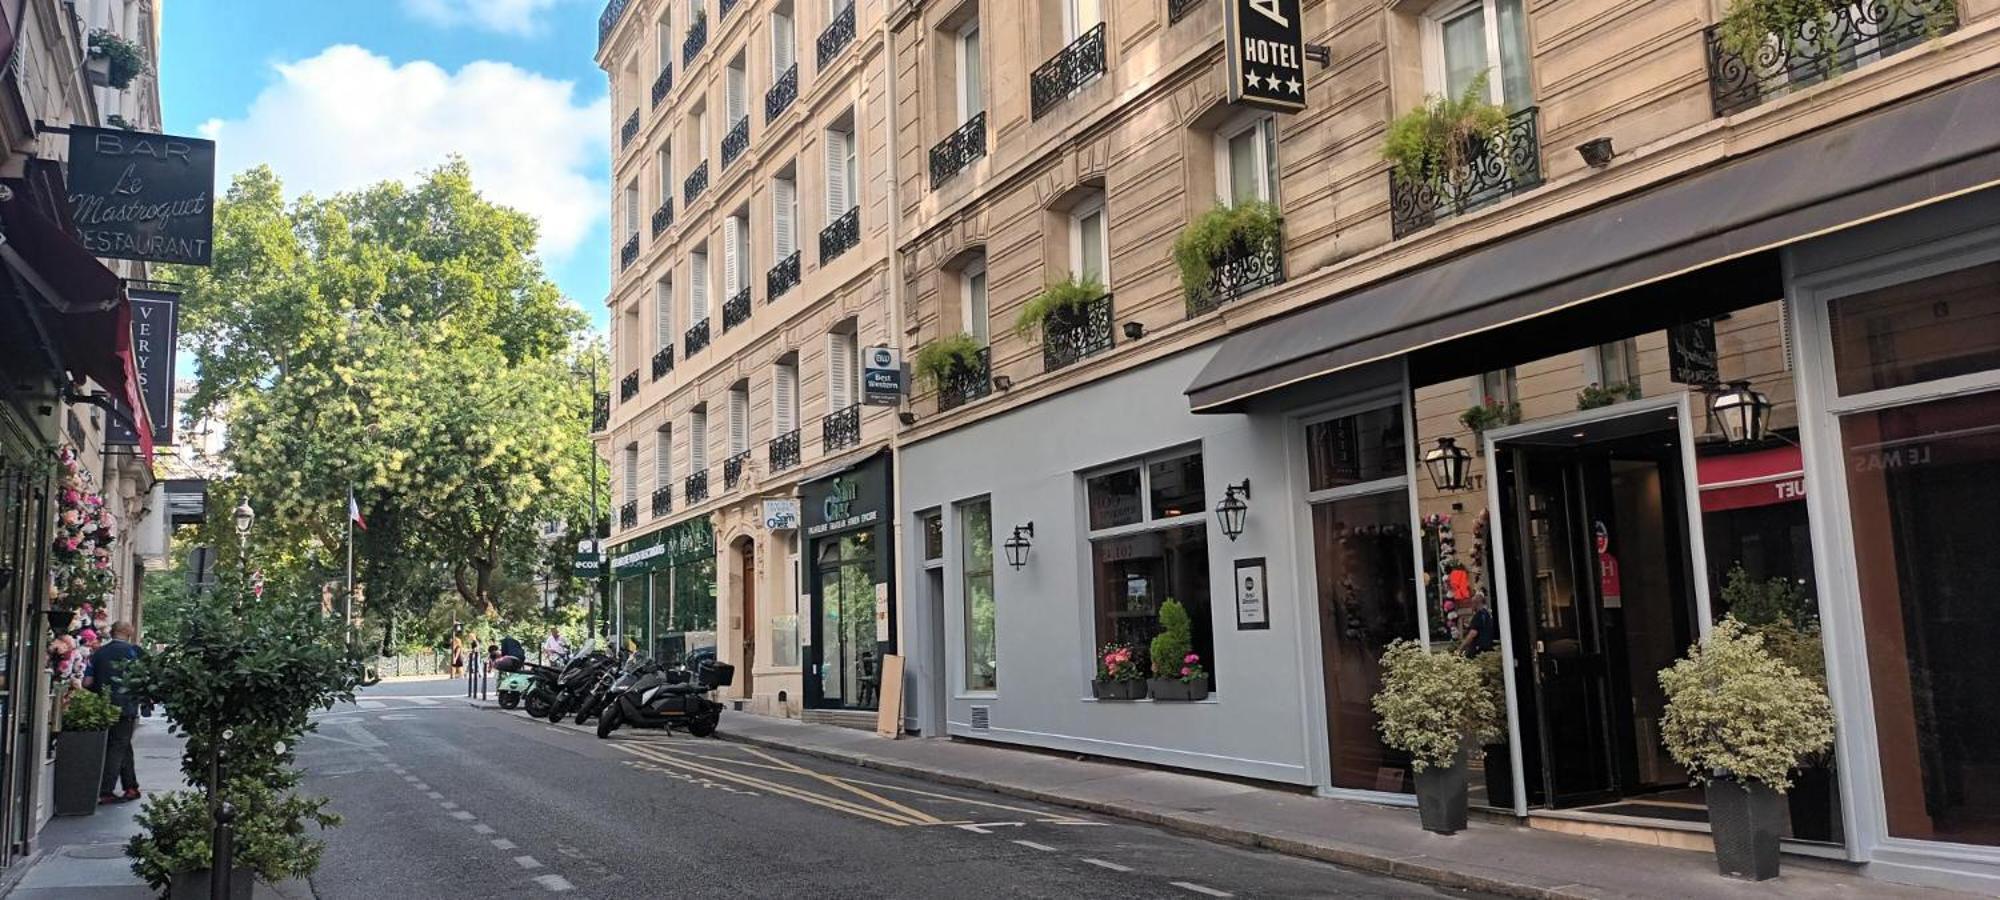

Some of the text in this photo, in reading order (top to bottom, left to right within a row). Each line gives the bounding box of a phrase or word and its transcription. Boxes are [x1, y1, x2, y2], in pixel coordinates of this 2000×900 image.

[1244, 36, 1300, 70] HOTEL
[95, 133, 192, 162] BAR
[111, 162, 144, 195] Le
[68, 192, 206, 231] Mastroquet
